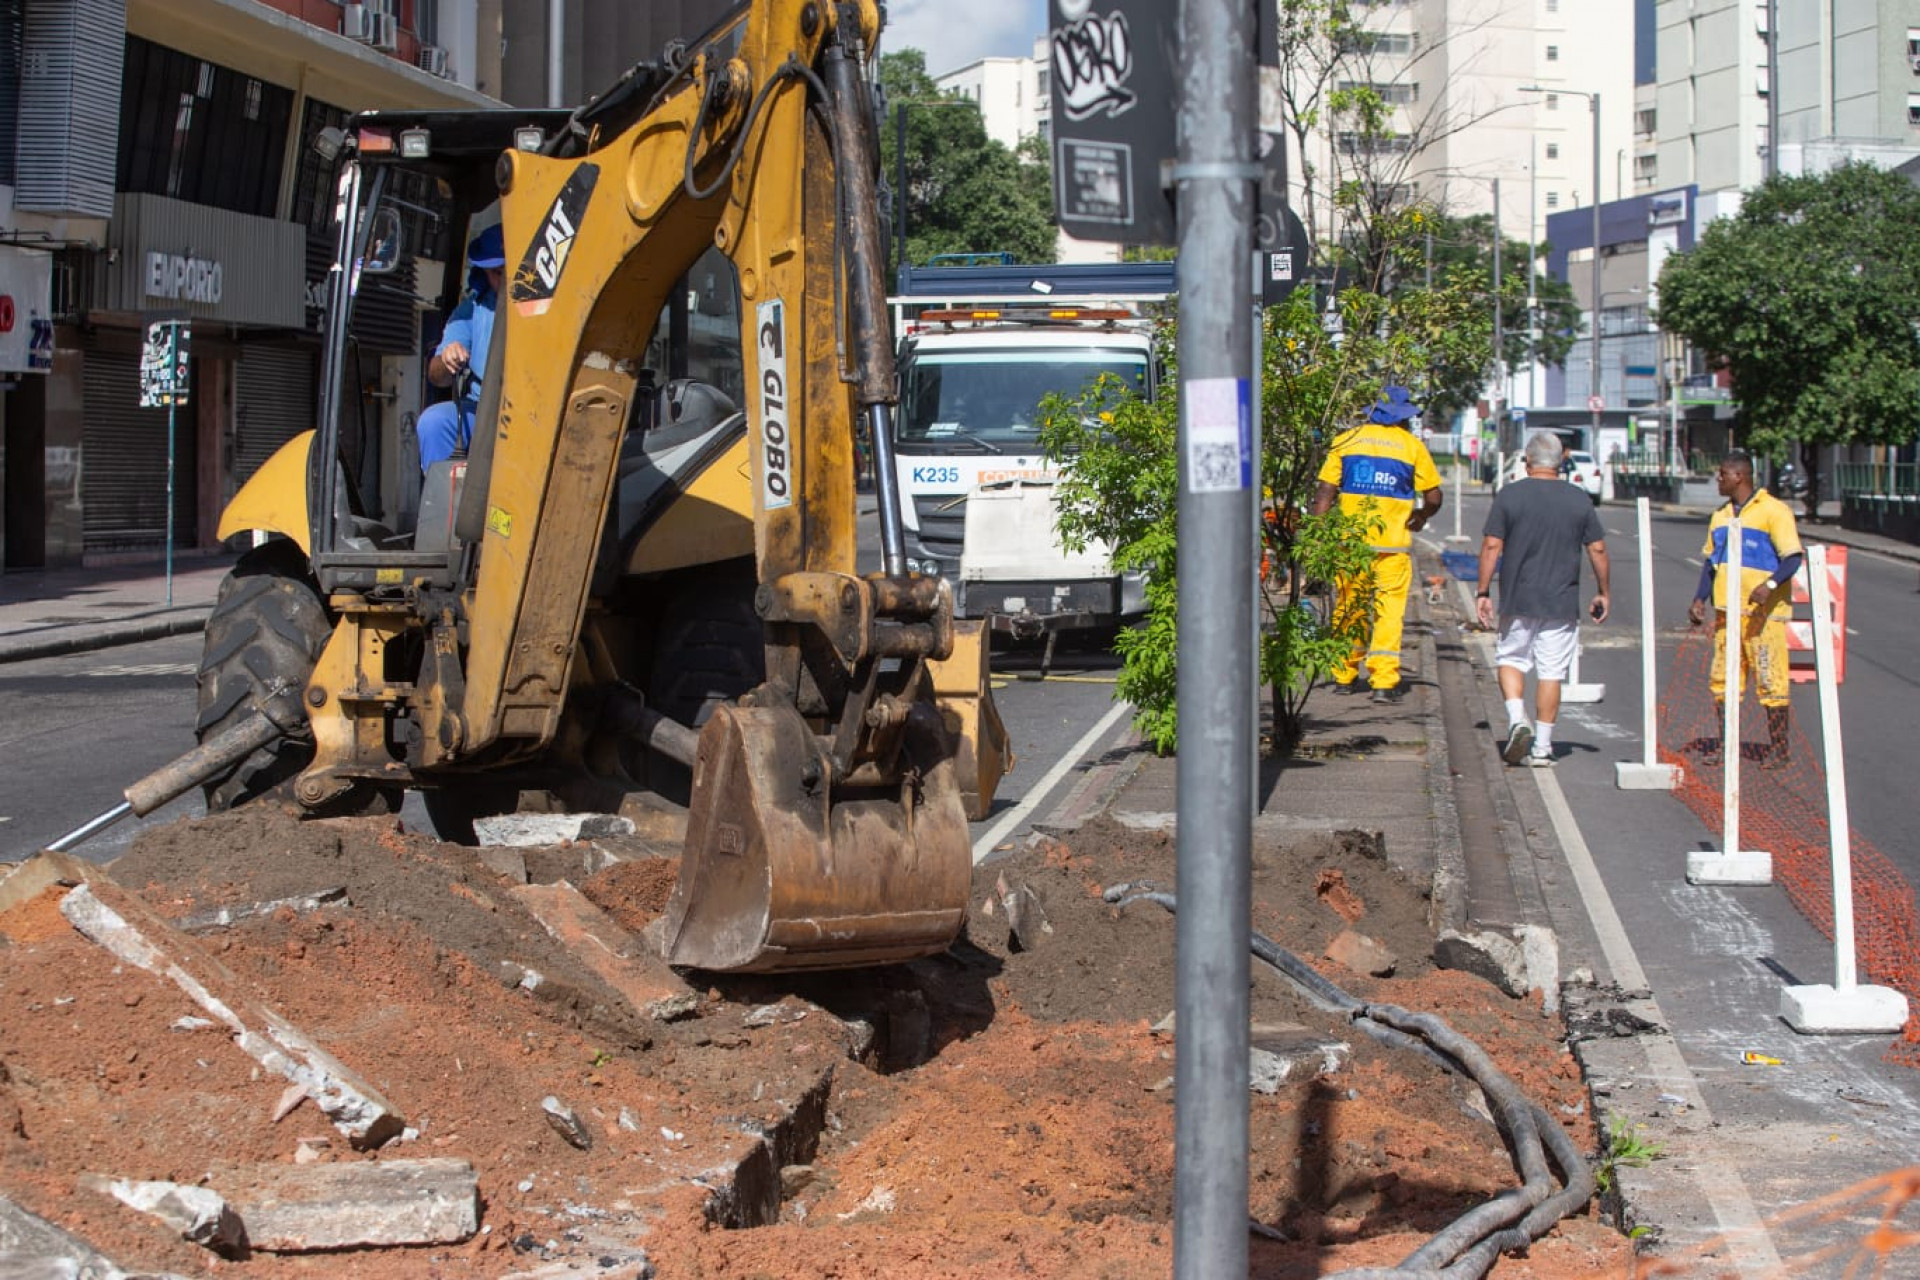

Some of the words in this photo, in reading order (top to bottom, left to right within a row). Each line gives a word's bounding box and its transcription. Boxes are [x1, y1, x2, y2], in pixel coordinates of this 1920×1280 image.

[535, 198, 576, 290] CAT
[763, 368, 787, 497] GLOBO
[912, 466, 960, 483] K235
[1374, 471, 1398, 486] Rio
